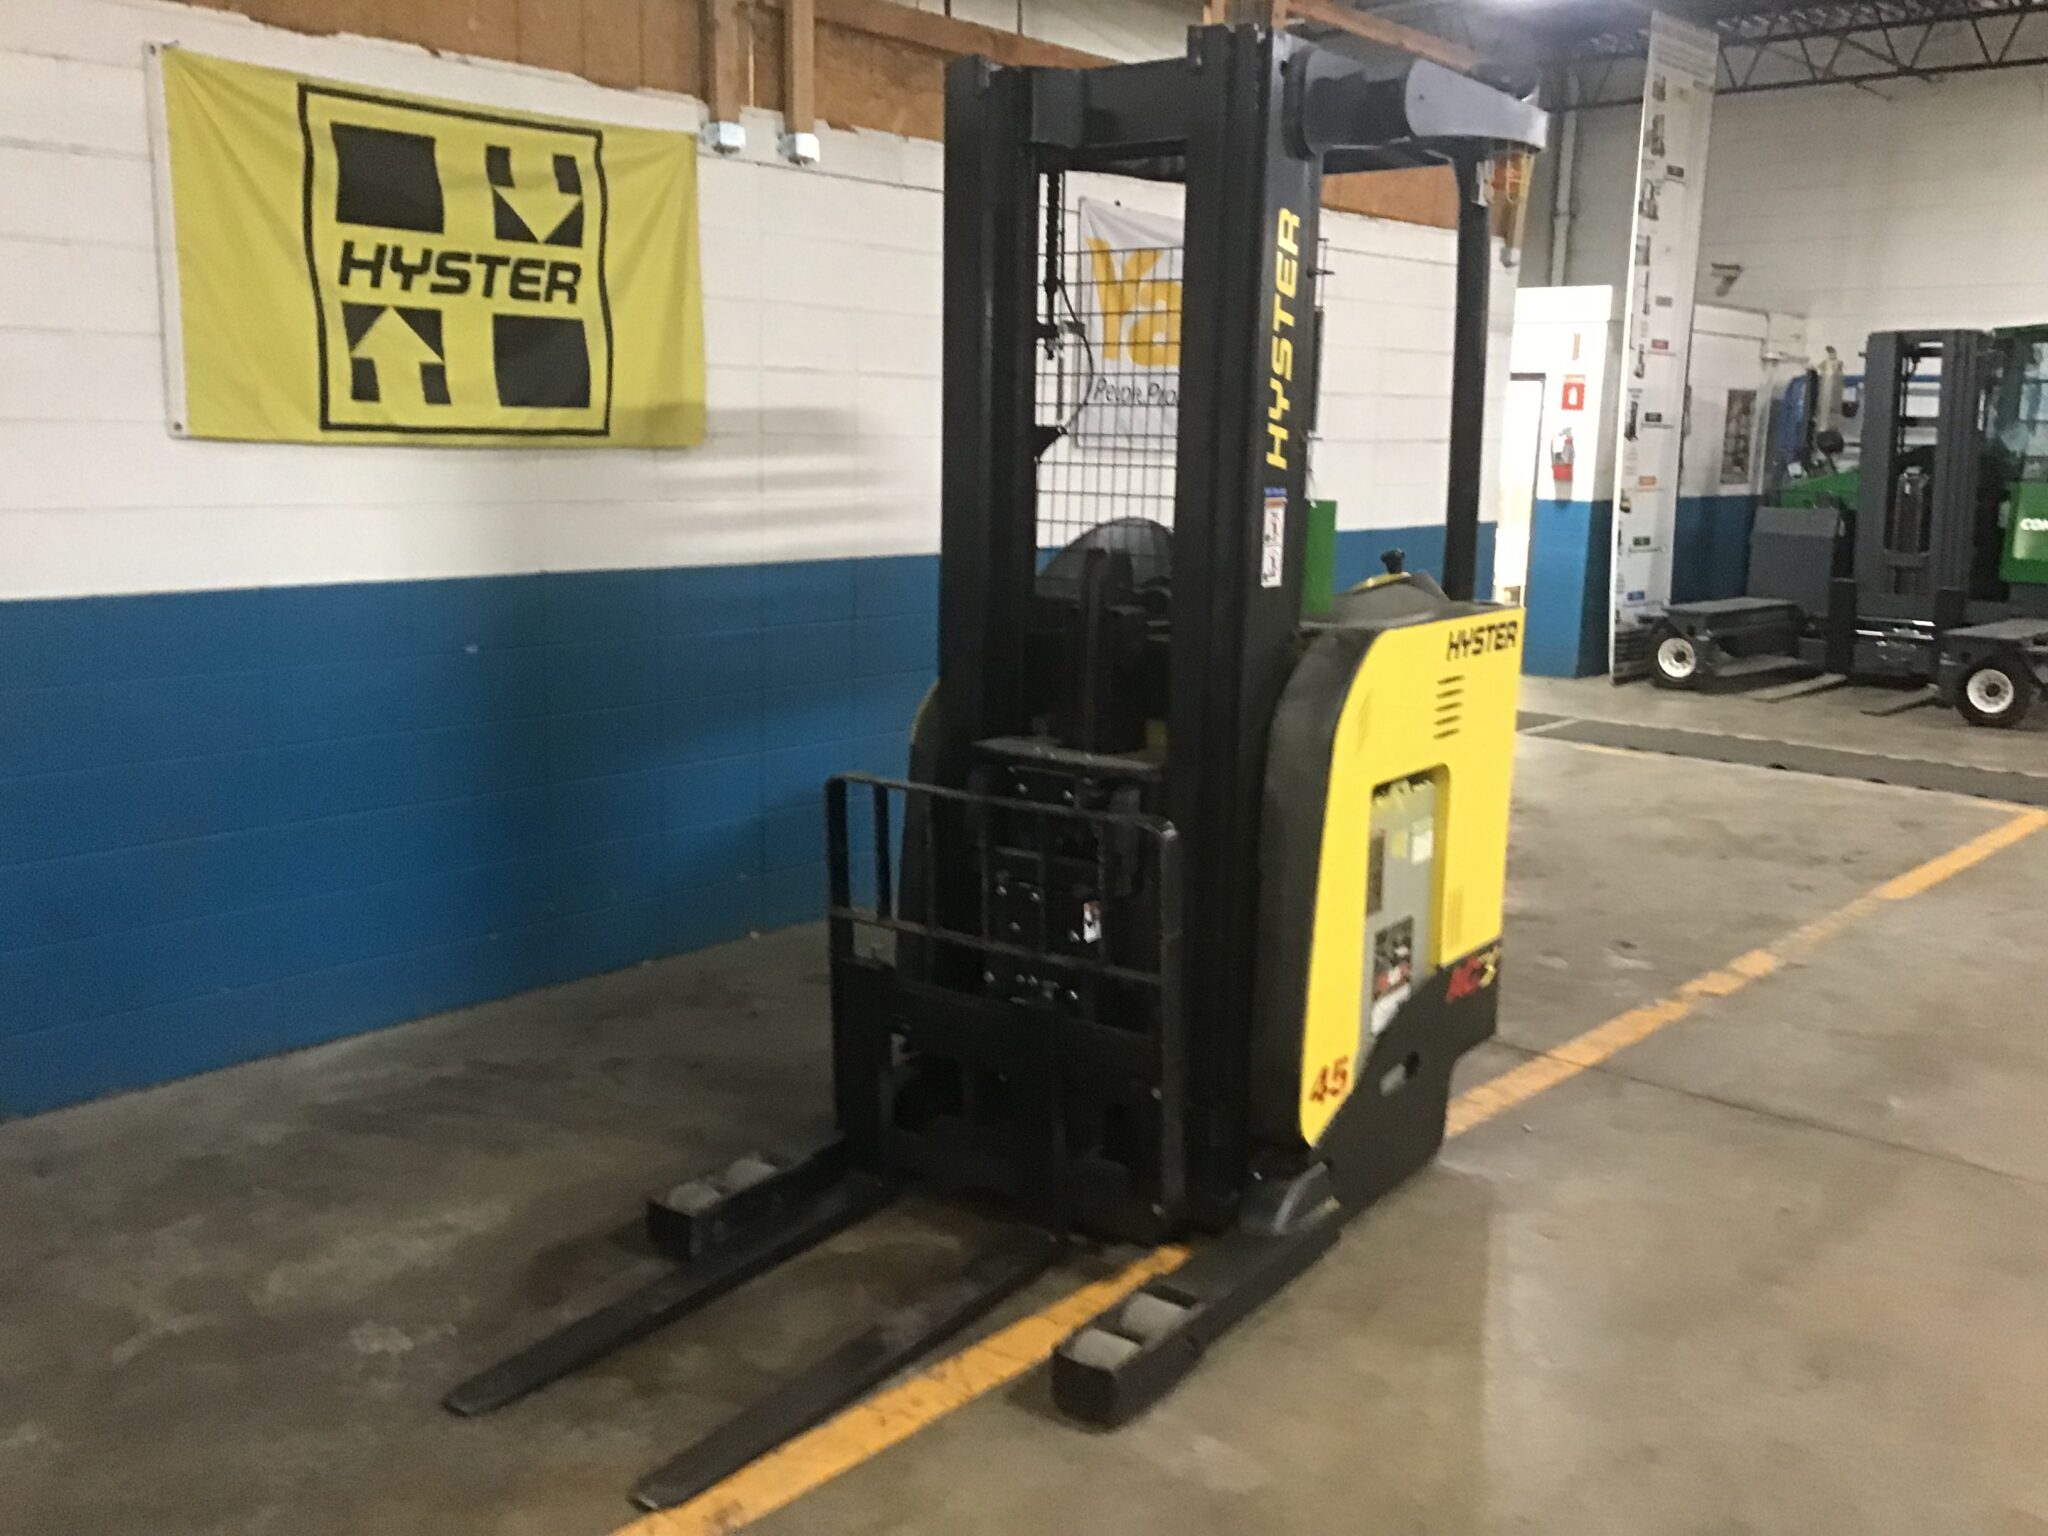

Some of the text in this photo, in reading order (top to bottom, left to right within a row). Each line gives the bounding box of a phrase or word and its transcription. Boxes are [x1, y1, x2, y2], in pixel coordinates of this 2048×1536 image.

[339, 240, 582, 303] HYSTER
[1265, 207, 1301, 470] HYSTER
[1445, 620, 1519, 661] HYSTER
[1310, 1055, 1349, 1105] 45
